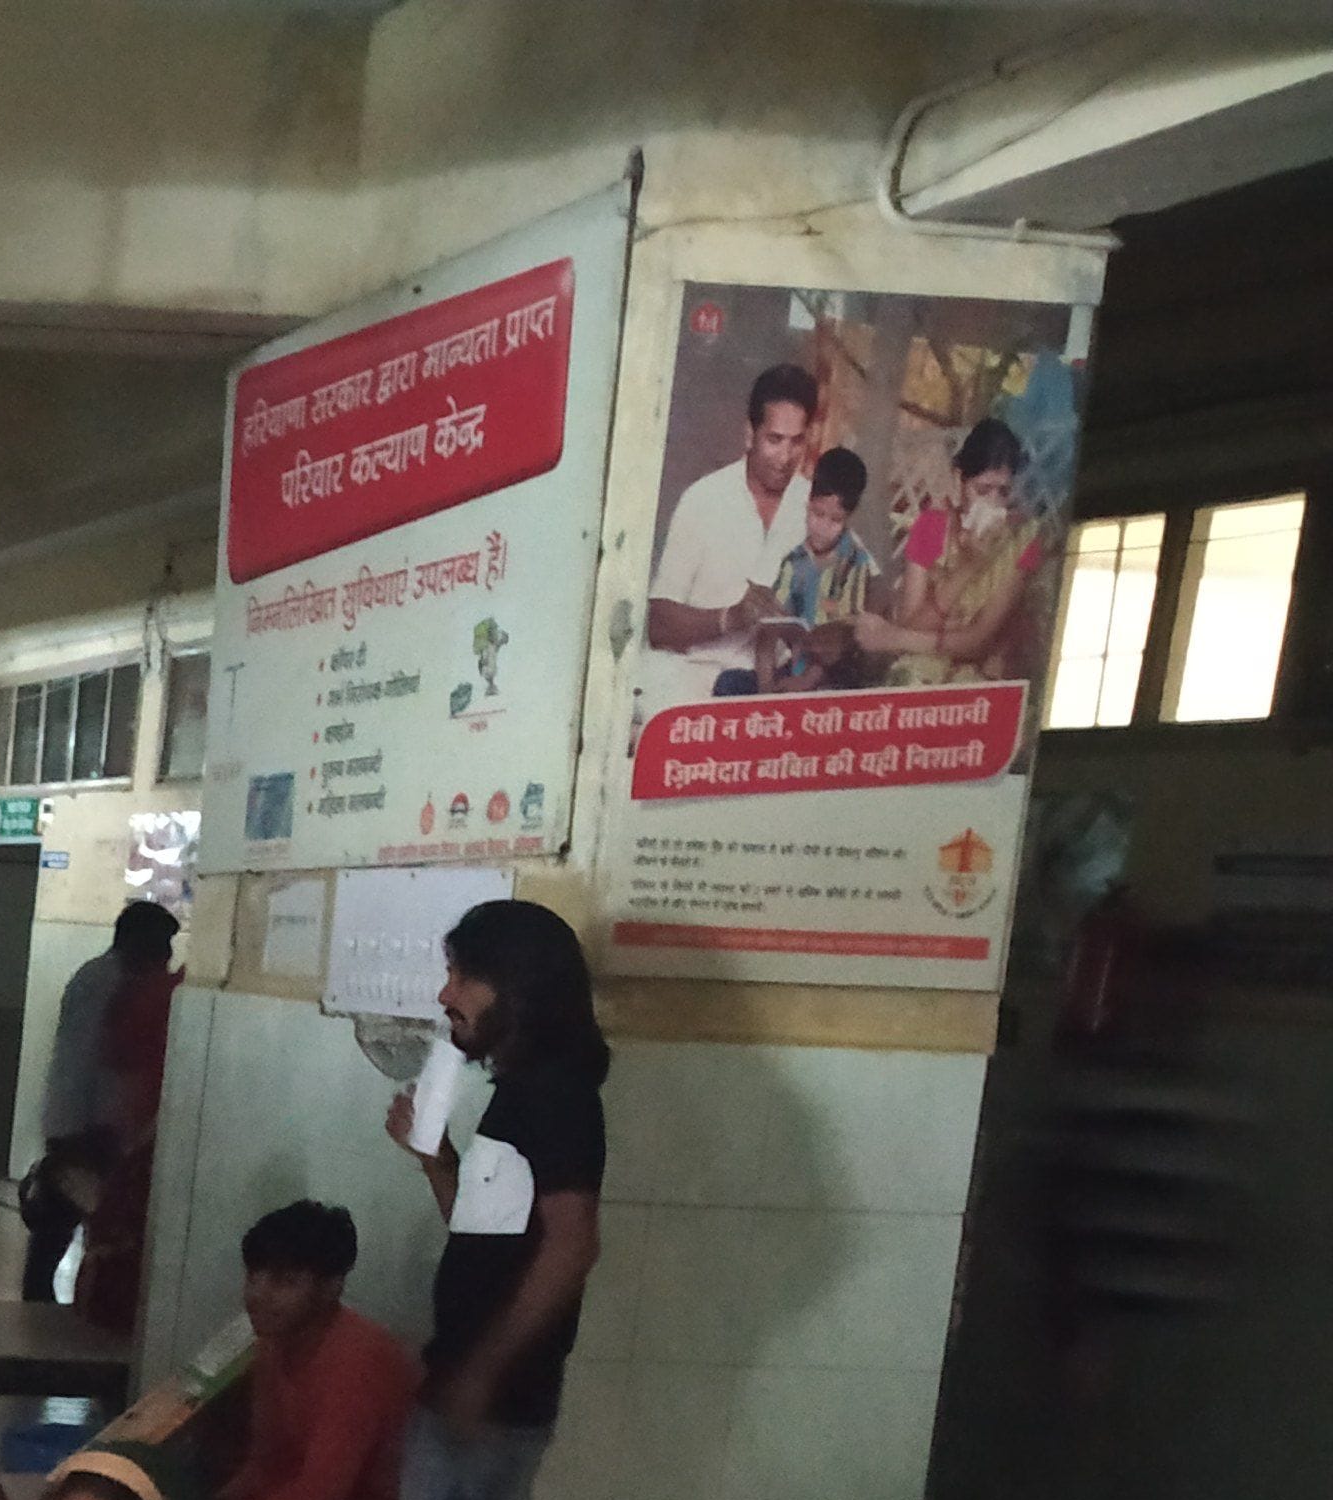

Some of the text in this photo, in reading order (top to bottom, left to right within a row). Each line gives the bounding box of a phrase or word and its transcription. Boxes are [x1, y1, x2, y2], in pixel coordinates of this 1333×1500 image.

[241, 295, 558, 458] हरियाणा सरकार द्वारा मान्यता प्राप्त
[281, 395, 488, 509] परिवार कल्याण केन्द्र
[413, 551, 481, 600] उपलब्ध
[721, 717, 741, 741] न
[801, 706, 844, 736] ऐसी
[898, 696, 991, 730] सावधानी
[824, 747, 856, 776] की
[905, 738, 986, 772] निशानी
